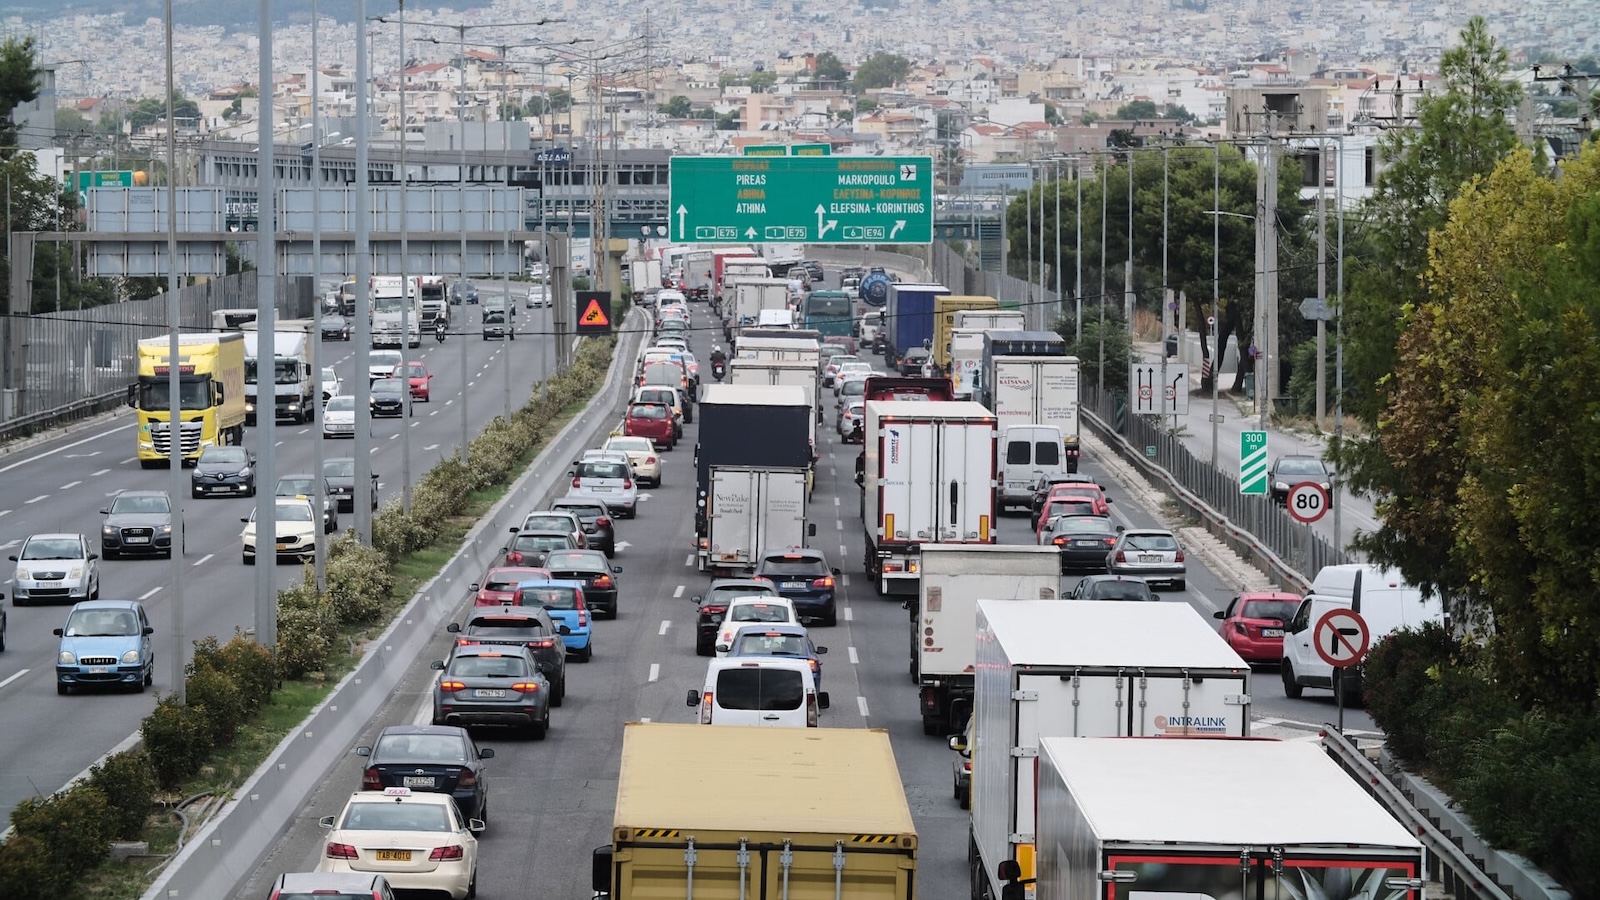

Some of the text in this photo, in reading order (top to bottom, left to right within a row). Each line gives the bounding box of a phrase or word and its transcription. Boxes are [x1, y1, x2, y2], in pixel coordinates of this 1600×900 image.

[736, 174, 767, 186] PIREAS
[838, 174, 896, 186] MARKOPOULO
[736, 202, 767, 214] ATHINA
[719, 228, 736, 237] E75
[788, 228, 805, 237] E75
[866, 228, 882, 237] E94
[1245, 433, 1263, 444] 300
[1249, 443, 1258, 451] m
[1296, 493, 1320, 510] 80
[1169, 716, 1226, 727] INTRALINK
